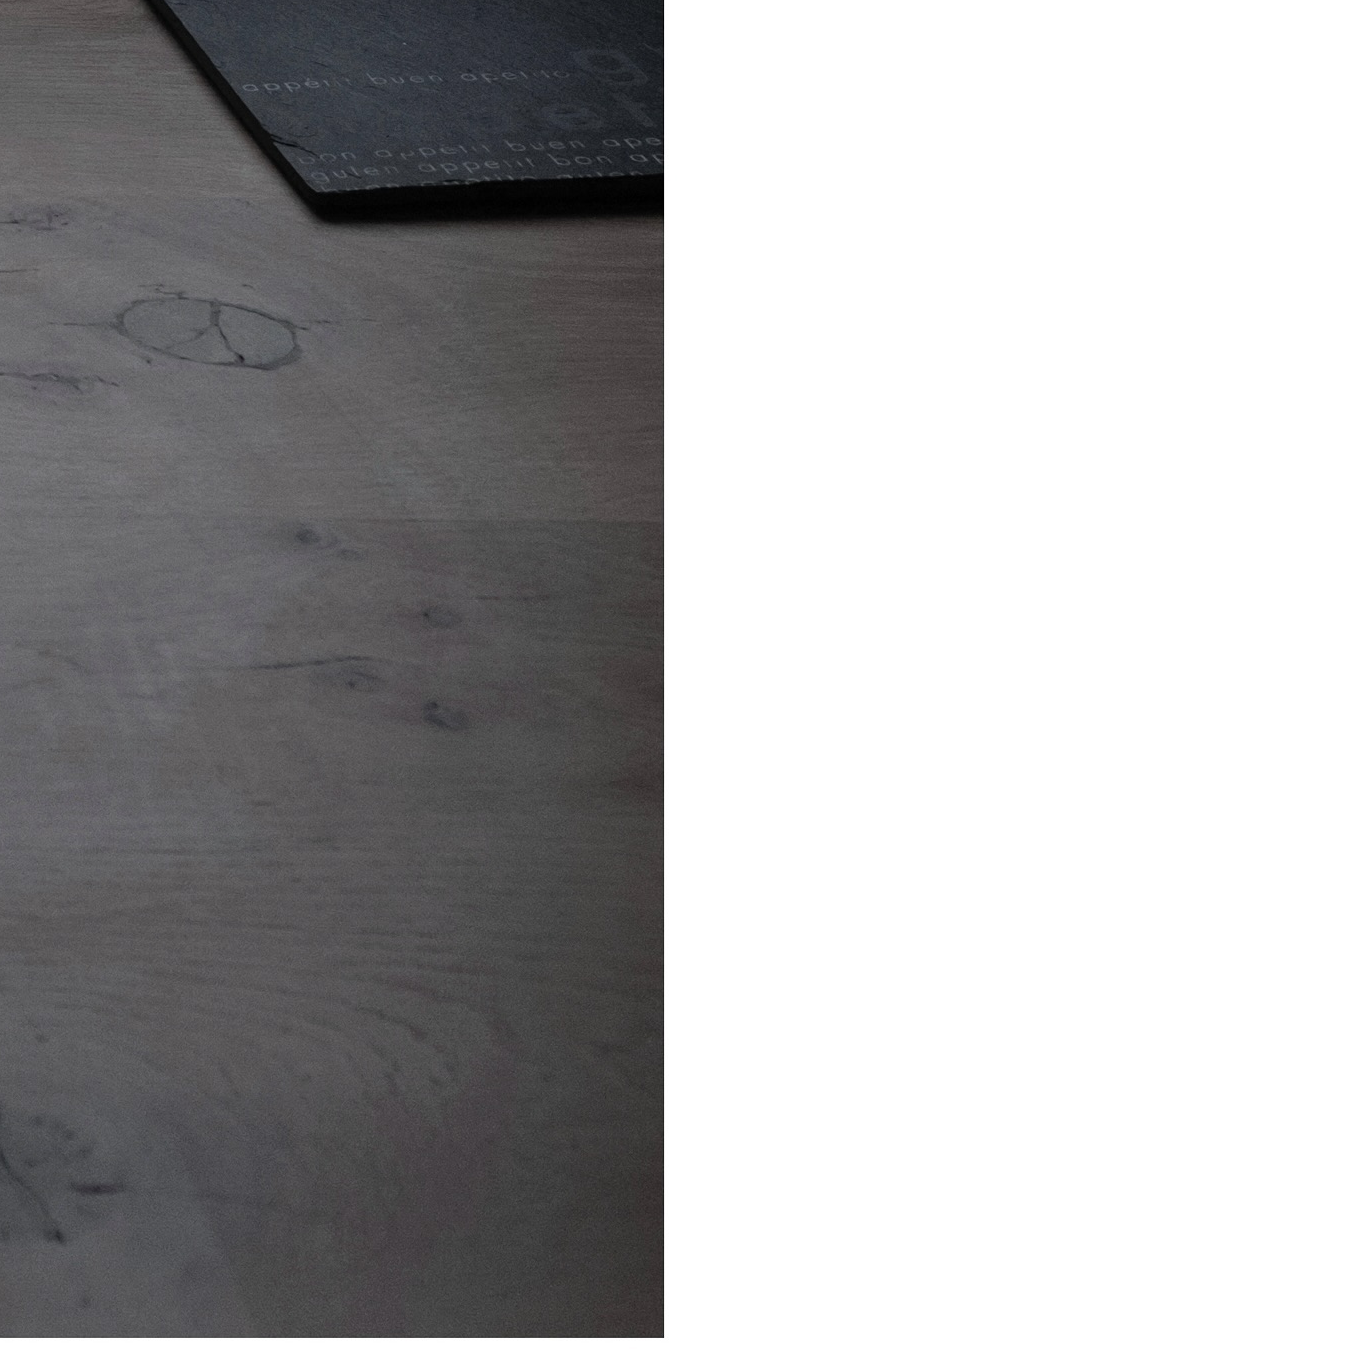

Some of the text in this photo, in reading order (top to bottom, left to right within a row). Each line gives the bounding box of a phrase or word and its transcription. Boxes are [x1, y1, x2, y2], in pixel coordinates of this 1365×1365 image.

[366, 72, 444, 86] buen
[503, 139, 586, 153] buen
[311, 165, 400, 183] guten
[547, 152, 614, 167] bon
